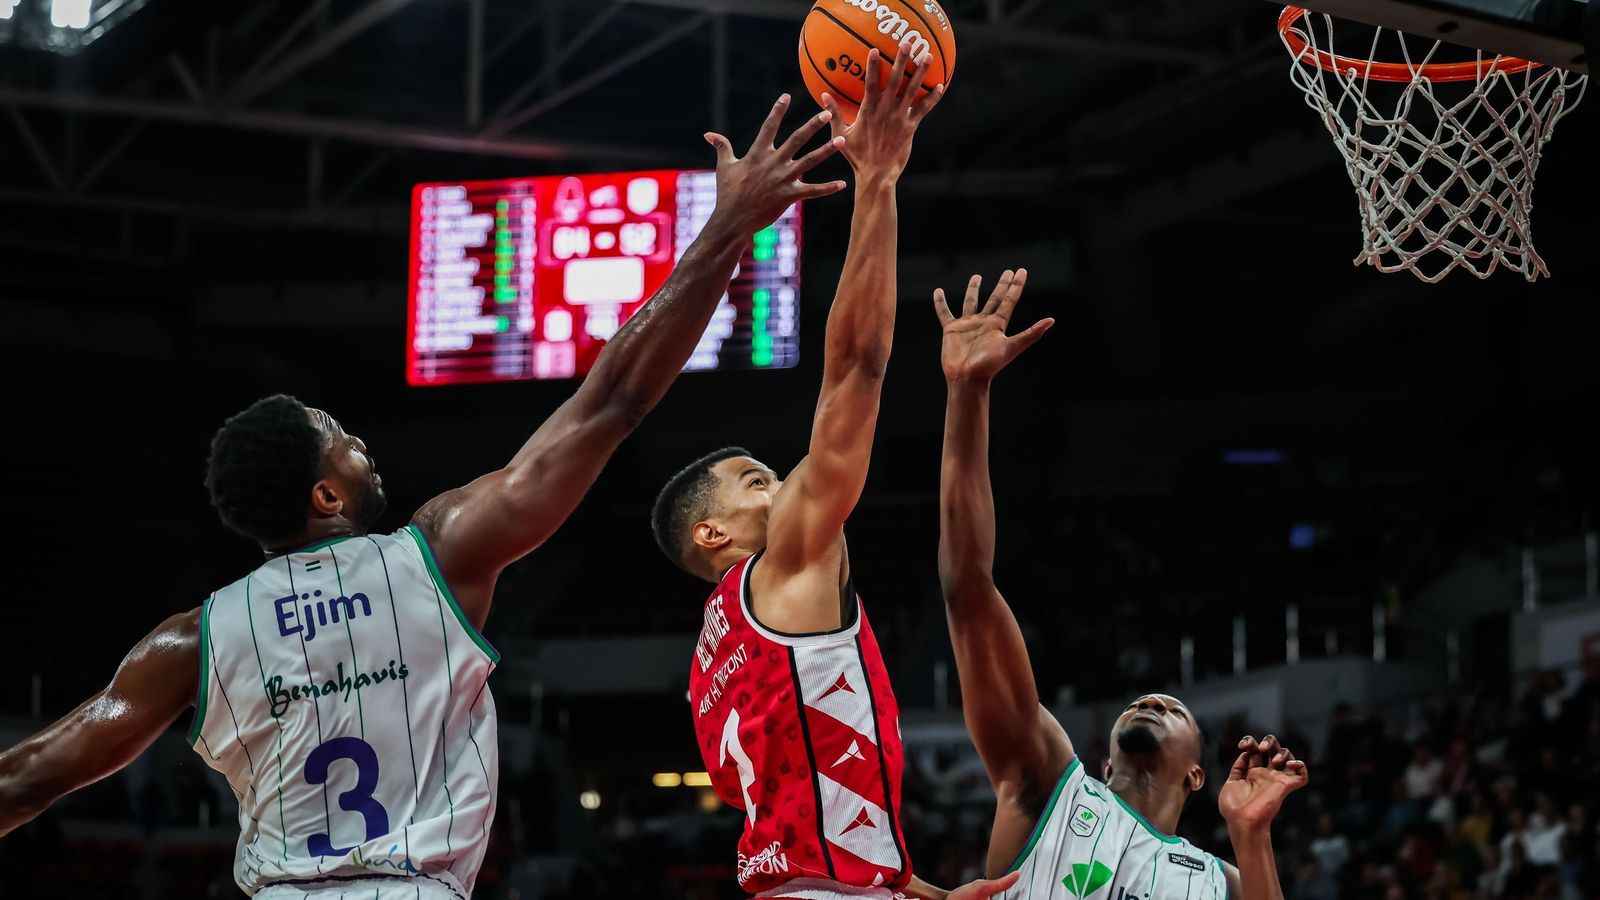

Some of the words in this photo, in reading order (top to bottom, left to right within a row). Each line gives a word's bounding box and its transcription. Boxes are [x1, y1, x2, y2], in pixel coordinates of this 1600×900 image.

[838, 54, 866, 83] cb
[274, 590, 372, 641] Ejim
[304, 737, 389, 857] 3
